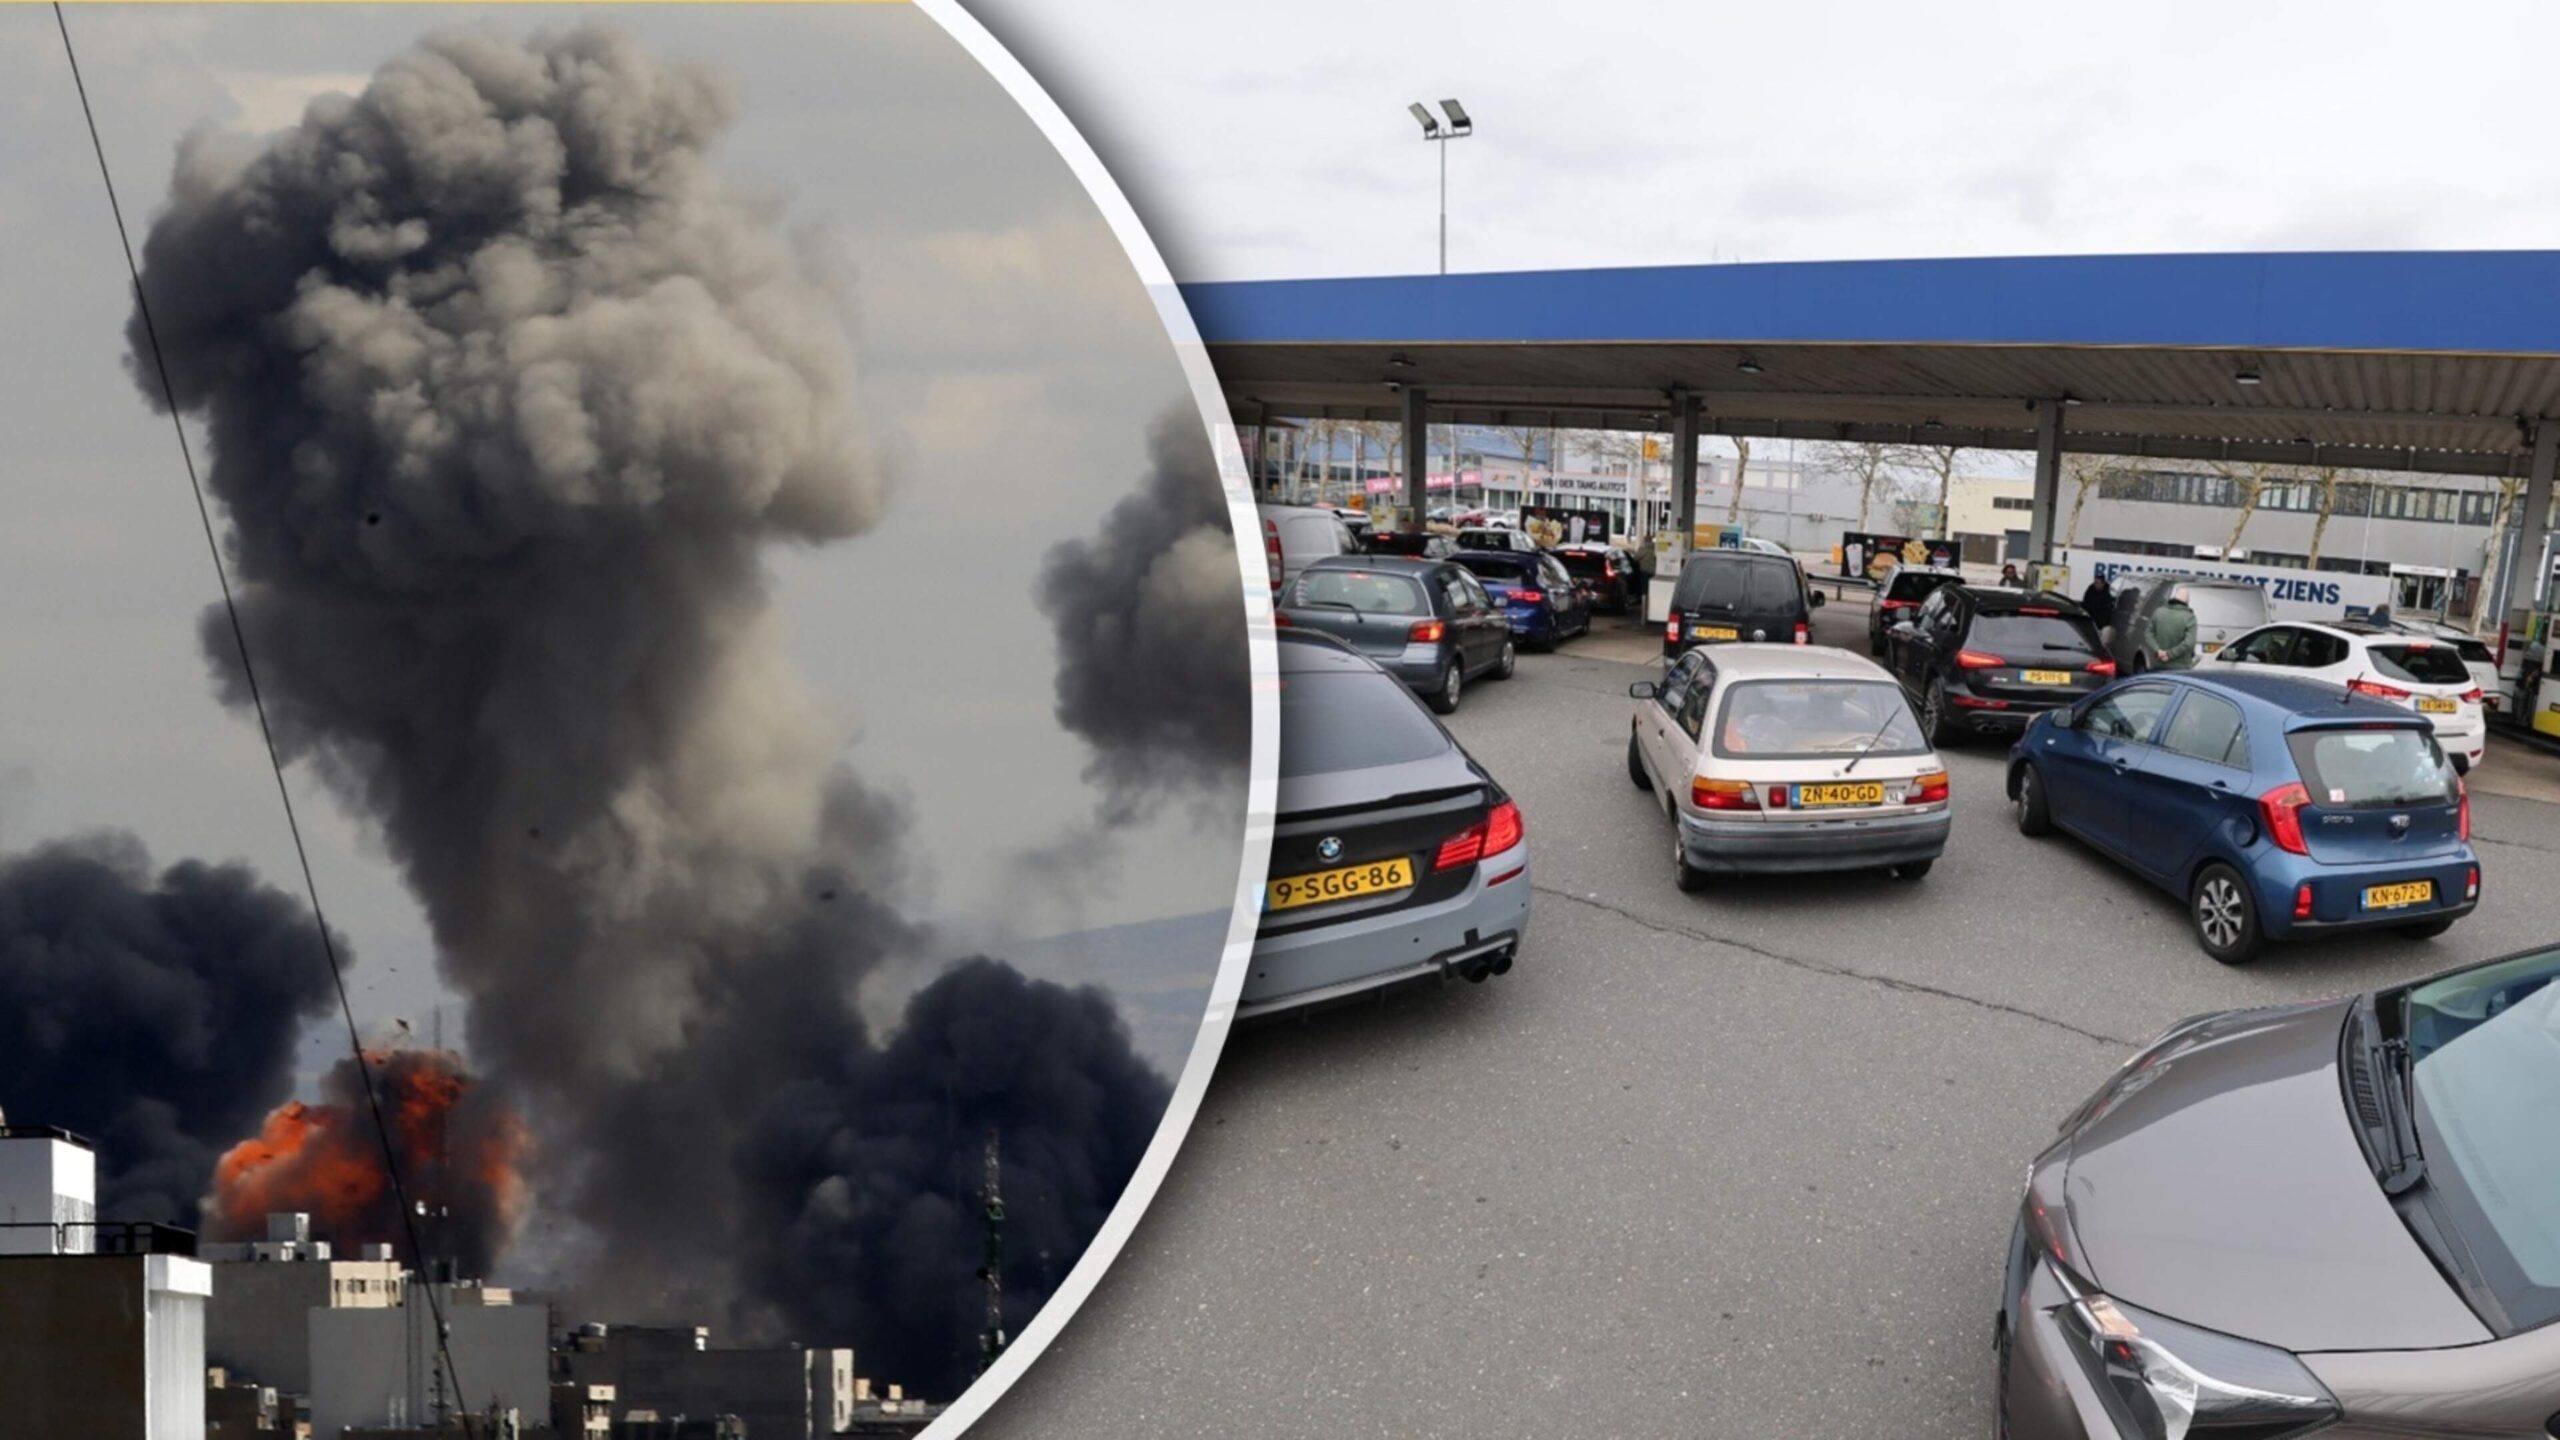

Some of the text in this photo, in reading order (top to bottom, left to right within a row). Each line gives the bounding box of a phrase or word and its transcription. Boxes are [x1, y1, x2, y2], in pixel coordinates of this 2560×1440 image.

[1559, 479, 1575, 489] DER
[1576, 480, 1597, 491] TANG
[1599, 482, 1627, 493] AUTO'S
[2273, 579, 2340, 605] ZIENS
[1803, 786, 1878, 803] ZN-40-GD
[1276, 864, 1401, 904] 9-SGG-86
[2371, 883, 2429, 904] KN-672-D
